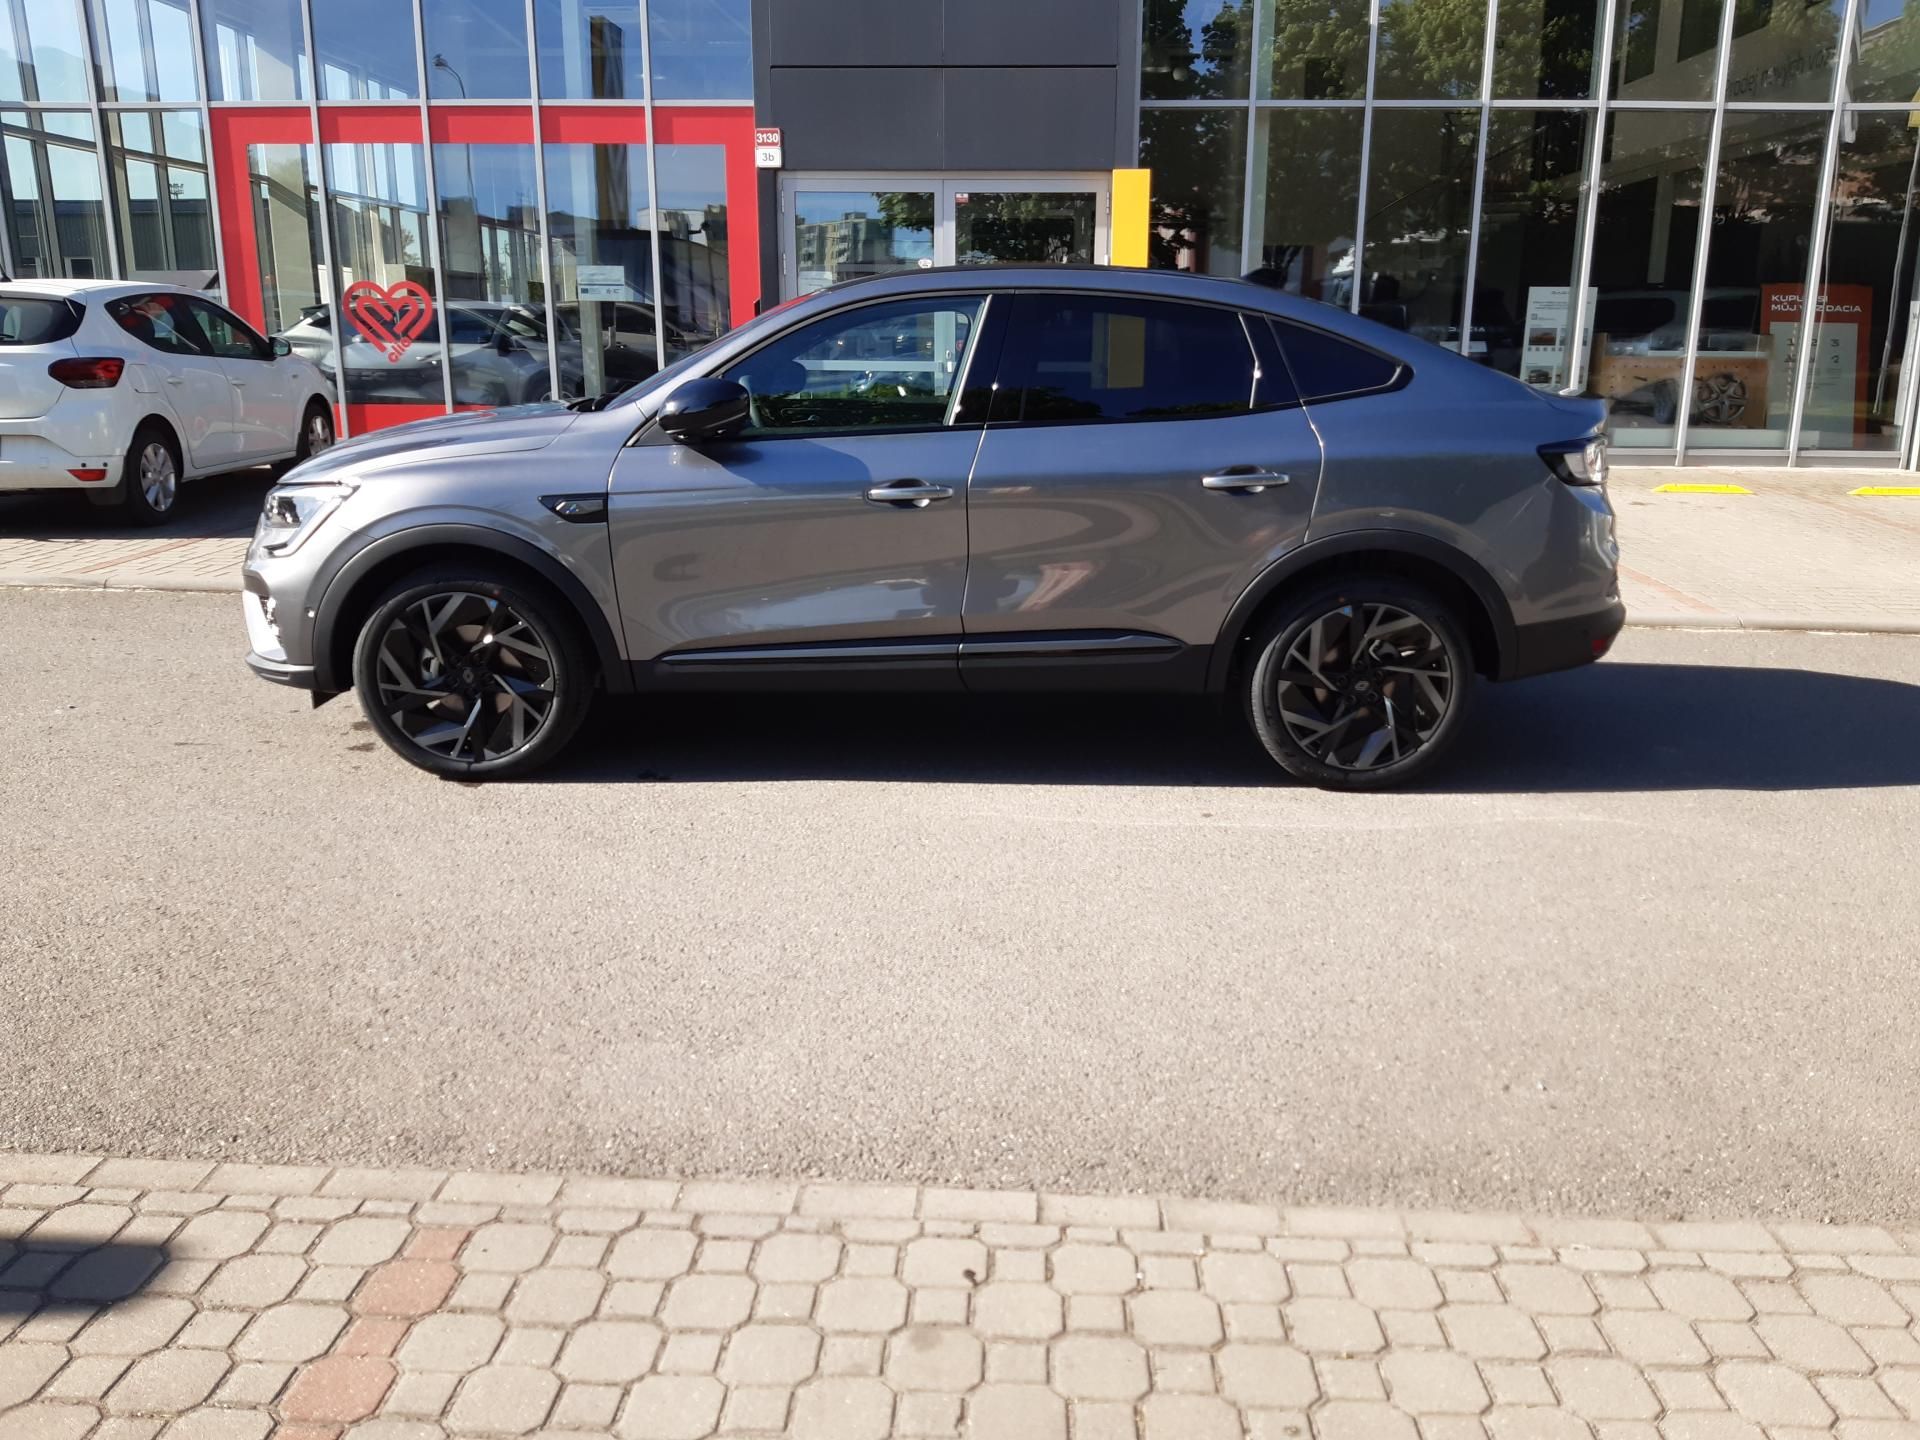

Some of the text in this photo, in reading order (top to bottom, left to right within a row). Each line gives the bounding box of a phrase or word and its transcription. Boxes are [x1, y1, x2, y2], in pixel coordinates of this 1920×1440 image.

[756, 132, 778, 143] 3130
[762, 152, 775, 161] 3b
[1825, 305, 1862, 313] DACIA
[387, 336, 412, 364] clio
